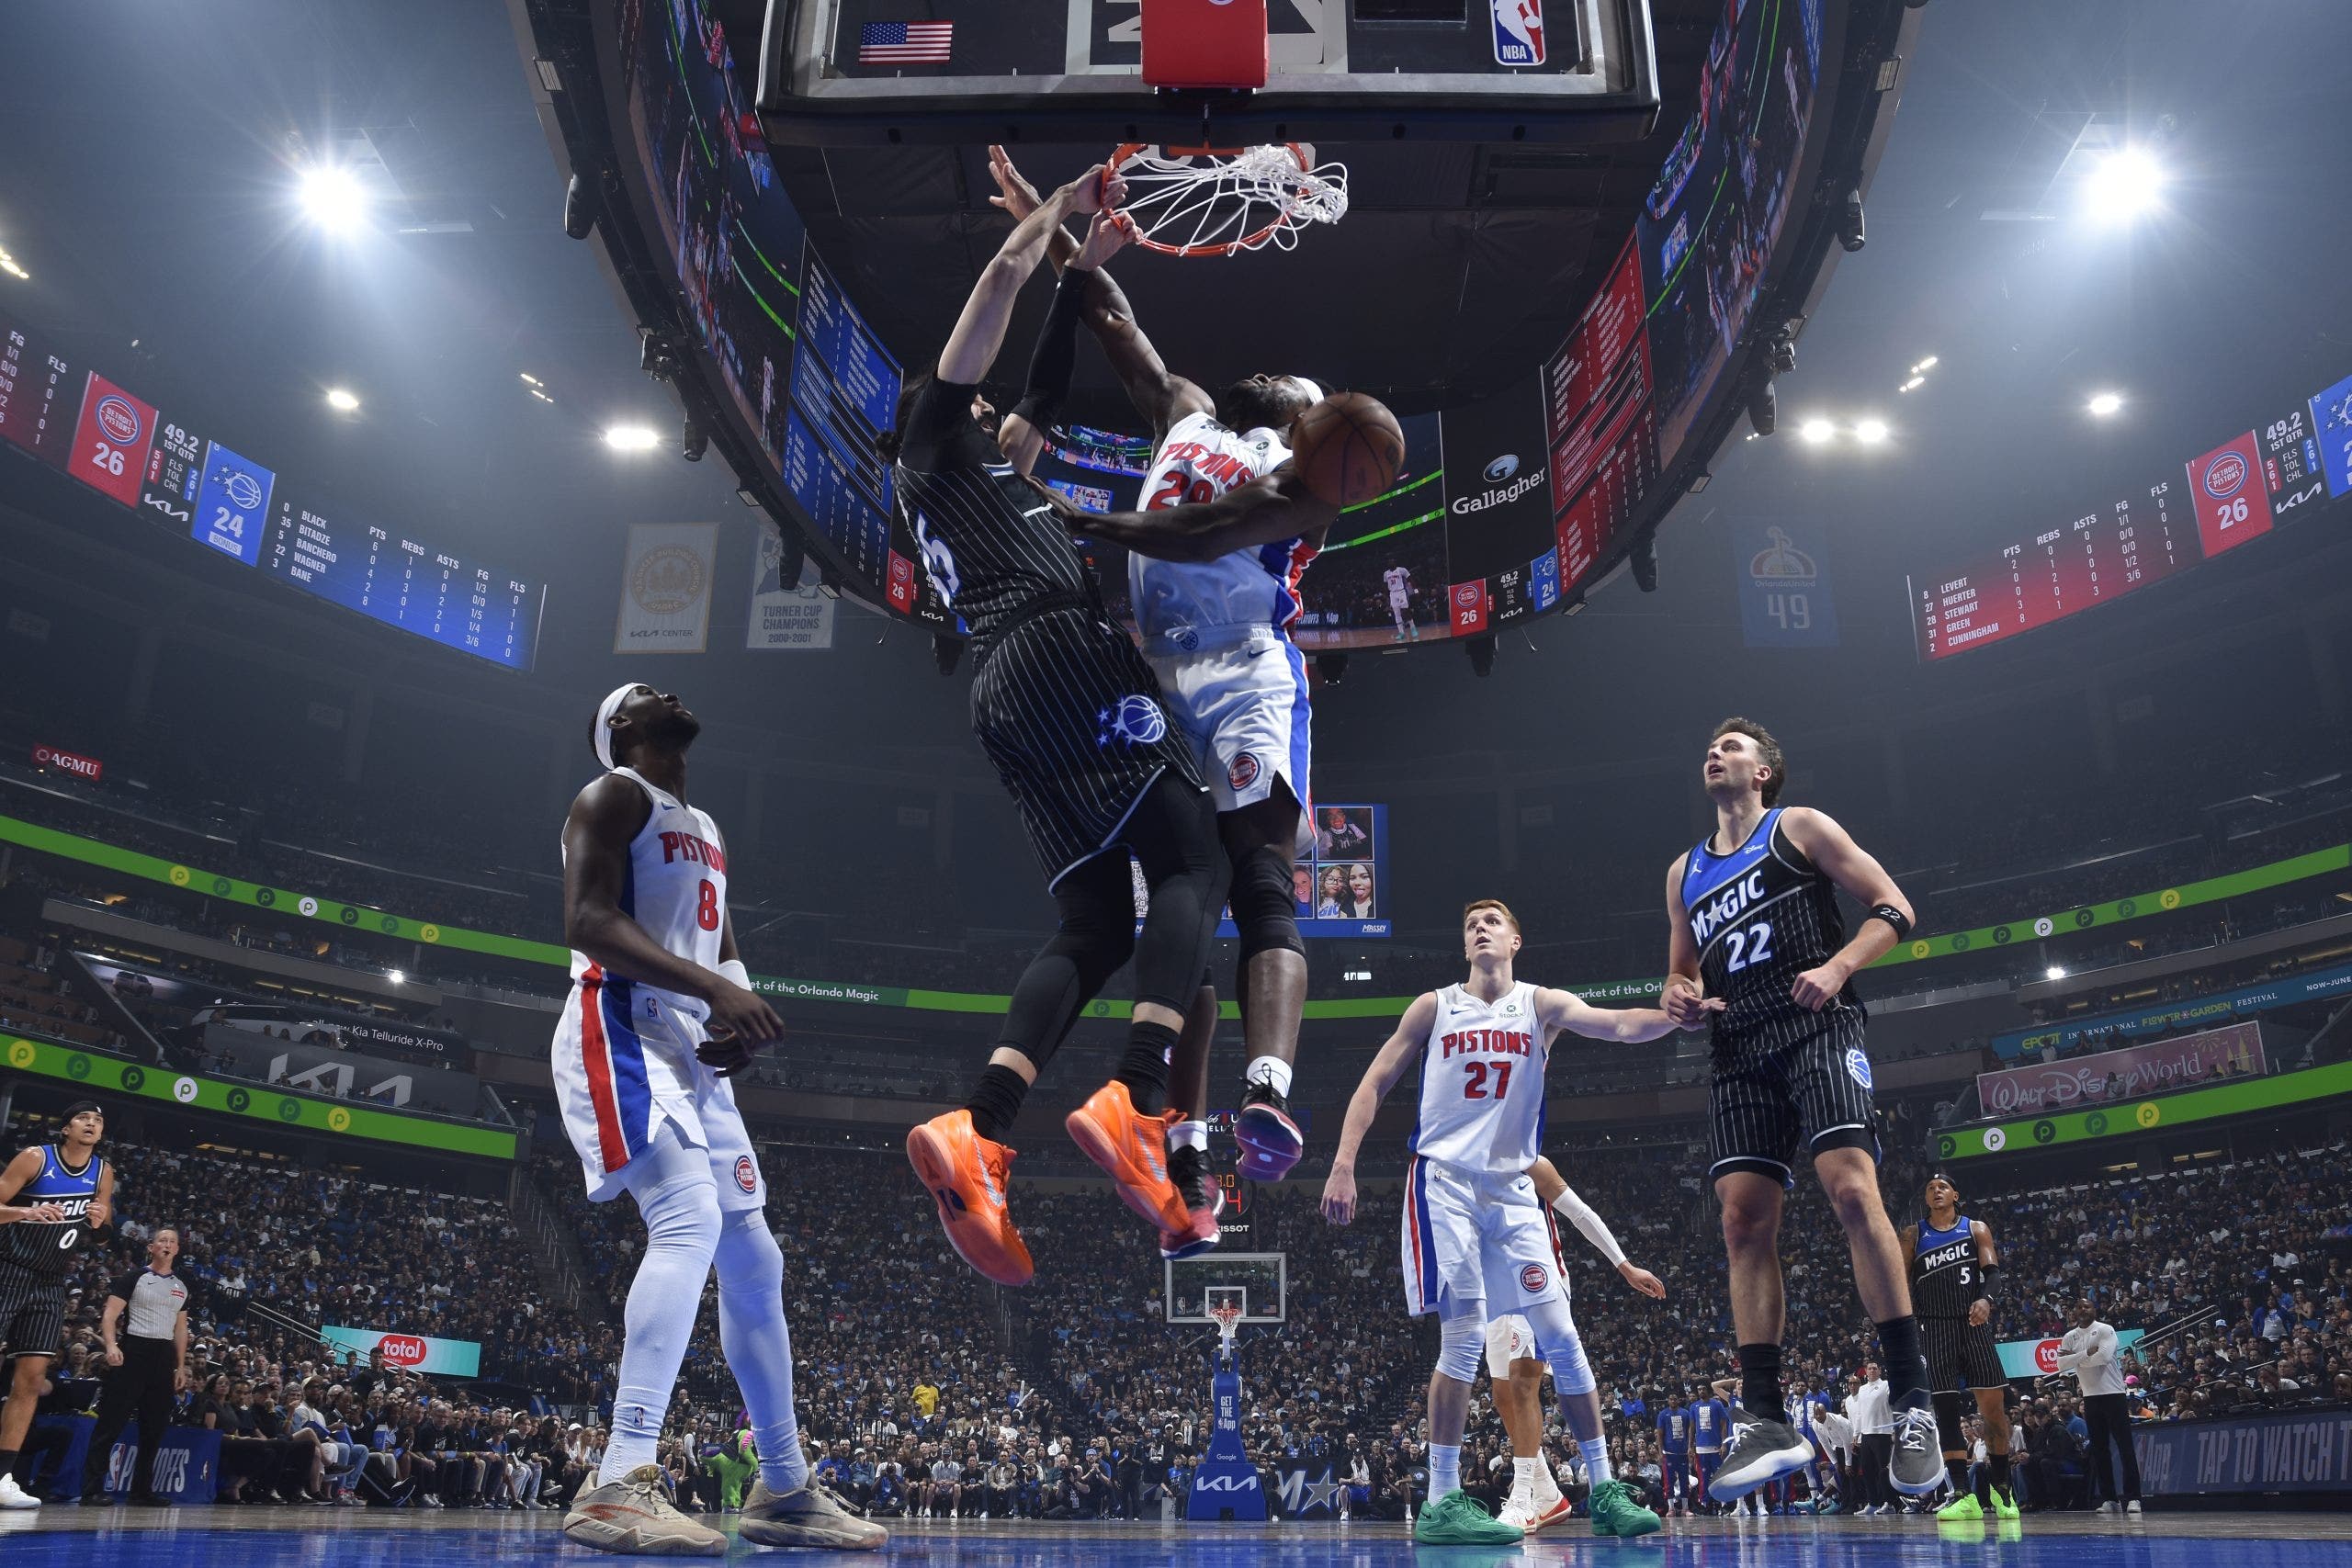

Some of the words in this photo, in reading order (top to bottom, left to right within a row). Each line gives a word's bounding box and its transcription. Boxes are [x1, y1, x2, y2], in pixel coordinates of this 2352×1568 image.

[1502, 45, 1527, 60] NBA
[10, 331, 25, 346] FG
[7, 345, 19, 360] 1/1
[48, 355, 67, 373] FLS
[1, 360, 17, 377] 0/0
[104, 414, 131, 434] PISTONS
[106, 407, 133, 426] DETROIT
[2267, 412, 2302, 441] 49.2
[164, 423, 199, 453] 49.2
[2270, 439, 2284, 451] 1ST
[2286, 428, 2303, 444] QTR
[92, 442, 125, 476] 26
[164, 439, 176, 452] 1ST
[178, 447, 195, 462] QTR
[2282, 448, 2298, 462] FLS
[152, 460, 158, 470] 6
[167, 468, 181, 482] TOL
[189, 480, 196, 490] 6
[153, 450, 161, 459] 5
[169, 458, 183, 472] FLS
[191, 470, 198, 480] 2
[2211, 463, 2238, 480] DETROIT
[2284, 459, 2301, 472] TOL
[2286, 469, 2302, 483] CHL
[150, 471, 155, 480] 1
[164, 479, 178, 493] CHL
[187, 491, 192, 501] 1
[2212, 469, 2240, 488] PISTONS
[1453, 468, 1545, 514] Gallagher
[213, 506, 243, 538] 24
[284, 502, 289, 512] 0
[301, 510, 327, 530] BLACK
[2004, 545, 2020, 558] PTS
[2036, 529, 2061, 546] REBS
[2074, 513, 2097, 531] ASTS
[2116, 501, 2128, 513] FG
[2151, 482, 2167, 497] FLS
[2217, 497, 2248, 531] 26
[212, 534, 239, 552] BONUS
[281, 516, 291, 528] 35
[299, 525, 331, 547] BITADZE
[278, 530, 284, 539] 5
[296, 538, 337, 563] BANCHERO
[1923, 591, 1928, 599] 8
[1940, 577, 1968, 594] LEVERT
[2011, 559, 2017, 570] 2
[2119, 514, 2129, 525] 1/1
[273, 558, 278, 568] 3
[290, 566, 311, 583] BANE
[276, 544, 286, 556] 22
[293, 551, 326, 574] WAGNER
[369, 526, 386, 540] PTS
[401, 539, 424, 556] REBS
[436, 554, 459, 570] ASTS
[478, 570, 489, 581] FG
[510, 581, 526, 593] FLS
[372, 542, 379, 551] 6
[476, 581, 486, 593] 1/3
[1925, 602, 1933, 613] 27
[1942, 588, 1976, 607] HUERTER
[2014, 573, 2018, 582] 0
[2120, 527, 2133, 540] 0/0
[1500, 571, 1518, 584] 49.2
[1543, 581, 1554, 597] 24
[1927, 615, 1937, 626] 28
[1944, 601, 1979, 621] STEWART
[2016, 586, 2021, 595] 0
[2122, 541, 2136, 554] 0/0
[368, 570, 373, 578] 4
[471, 608, 482, 620] 1/5
[472, 595, 485, 607] 0/0
[892, 582, 904, 600] 26
[1928, 629, 1937, 638] 31
[1946, 618, 1971, 634] GREEN
[2018, 600, 2023, 609] 3
[2125, 555, 2137, 568] 1/2
[365, 582, 370, 592] 2
[469, 622, 480, 633] 1/4
[763, 605, 800, 618] TURNER
[803, 605, 822, 617] CUP
[1461, 610, 1476, 625] 26
[1767, 594, 1810, 628] 49
[1929, 643, 1935, 652] 2
[1948, 622, 2000, 648] CUNNINGHAM
[2127, 569, 2141, 582] 3/6
[662, 629, 693, 637] CENTER
[763, 618, 820, 631] CHAMPIONS
[466, 635, 479, 647] 3/6
[51, 752, 98, 776] AGMU
[697, 879, 718, 931] 8
[1880, 908, 1901, 922] 22
[1726, 922, 1771, 974] 22
[763, 980, 775, 991] of
[777, 983, 795, 994] the
[798, 985, 842, 998] Orlando
[846, 988, 879, 1001] Magic
[1610, 986, 1621, 996] of
[1623, 985, 1642, 995] the
[2190, 1001, 2232, 1018] GARDEN
[2237, 993, 2278, 1007] FESTIVAL
[353, 1026, 368, 1037] Kia
[372, 1029, 413, 1045] Telluride
[415, 1037, 444, 1052] X-Pro
[1441, 1029, 1532, 1059] PISTONS
[1464, 1061, 1512, 1100] 27
[2137, 1053, 2202, 1084] World
[59, 1229, 77, 1249] 0
[1960, 1268, 1970, 1284] 5
[384, 1340, 420, 1359] total
[1221, 1396, 1232, 1406] GET
[1221, 1407, 1232, 1417] THE
[1223, 1419, 1236, 1431] App
[2197, 1430, 2230, 1483] TAP
[2233, 1427, 2257, 1483] TO
[2262, 1422, 2334, 1482] WATCH
